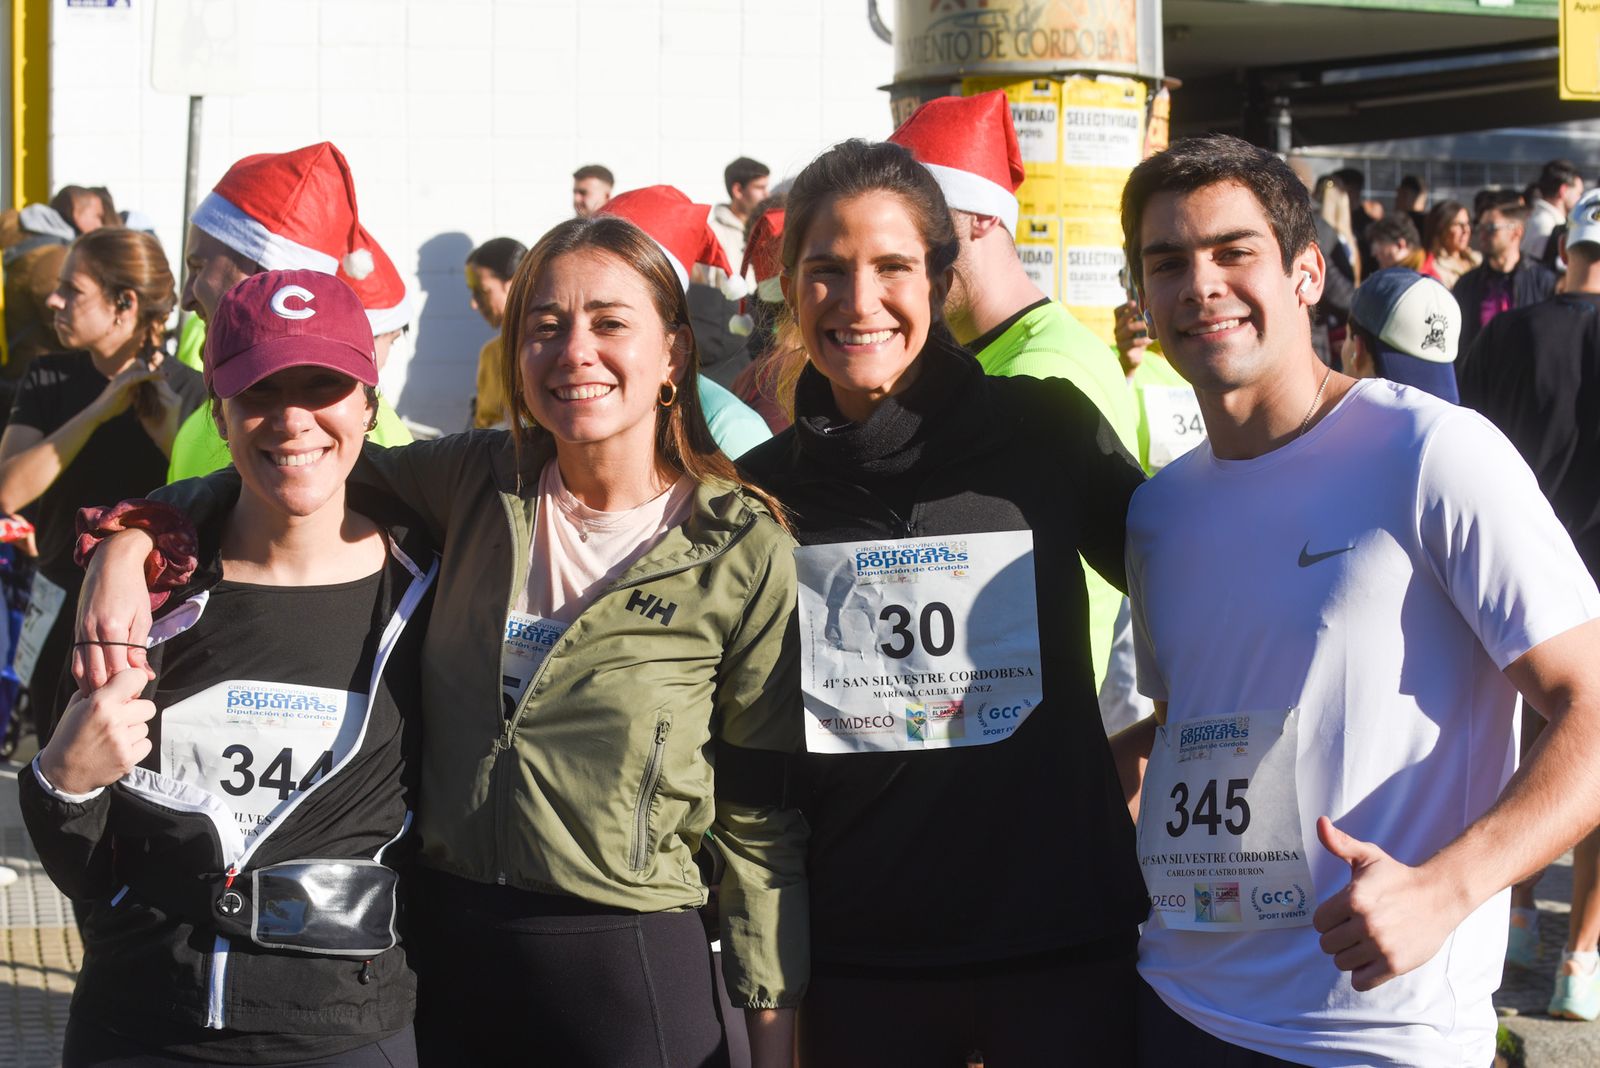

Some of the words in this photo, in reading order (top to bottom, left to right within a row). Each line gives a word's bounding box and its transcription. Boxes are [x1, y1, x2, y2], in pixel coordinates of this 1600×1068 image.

[978, 30, 1006, 58] DE
[271, 284, 317, 320] C
[856, 546, 950, 560] carreras
[896, 541, 948, 550] PROVINCIAL
[856, 552, 969, 571] populares
[857, 568, 910, 577] Diputación
[912, 565, 925, 573] de
[927, 563, 969, 572] Córdoba
[625, 589, 678, 627] HH
[508, 620, 560, 640] rrera
[879, 601, 955, 659] 30
[843, 676, 869, 688] SAN
[872, 671, 946, 687] SILVESTRE
[949, 667, 1034, 682] CORDOBESA
[227, 690, 321, 705] carreras
[905, 687, 950, 697] ALCALDE
[227, 697, 338, 713] populares
[989, 705, 1022, 720] GCC
[226, 708, 280, 717] Diputación
[297, 712, 338, 721] Córdoba
[834, 715, 895, 730] IMDECO
[1180, 722, 1237, 738] carreras
[983, 728, 1005, 736] SPORT
[1180, 728, 1249, 748] populares
[220, 744, 334, 801] 344
[1166, 778, 1251, 838] 345
[1150, 854, 1168, 865] SAN
[1169, 852, 1227, 864] SILVESTRE
[1229, 850, 1299, 863] CORDOBESA
[1166, 868, 1195, 877] CARLOS
[1196, 868, 1208, 876] DE
[1208, 868, 1237, 877] CASTRO
[1261, 890, 1294, 905] GCC
[1258, 913, 1280, 921] SPORT
[1281, 910, 1306, 919] EVENTS
